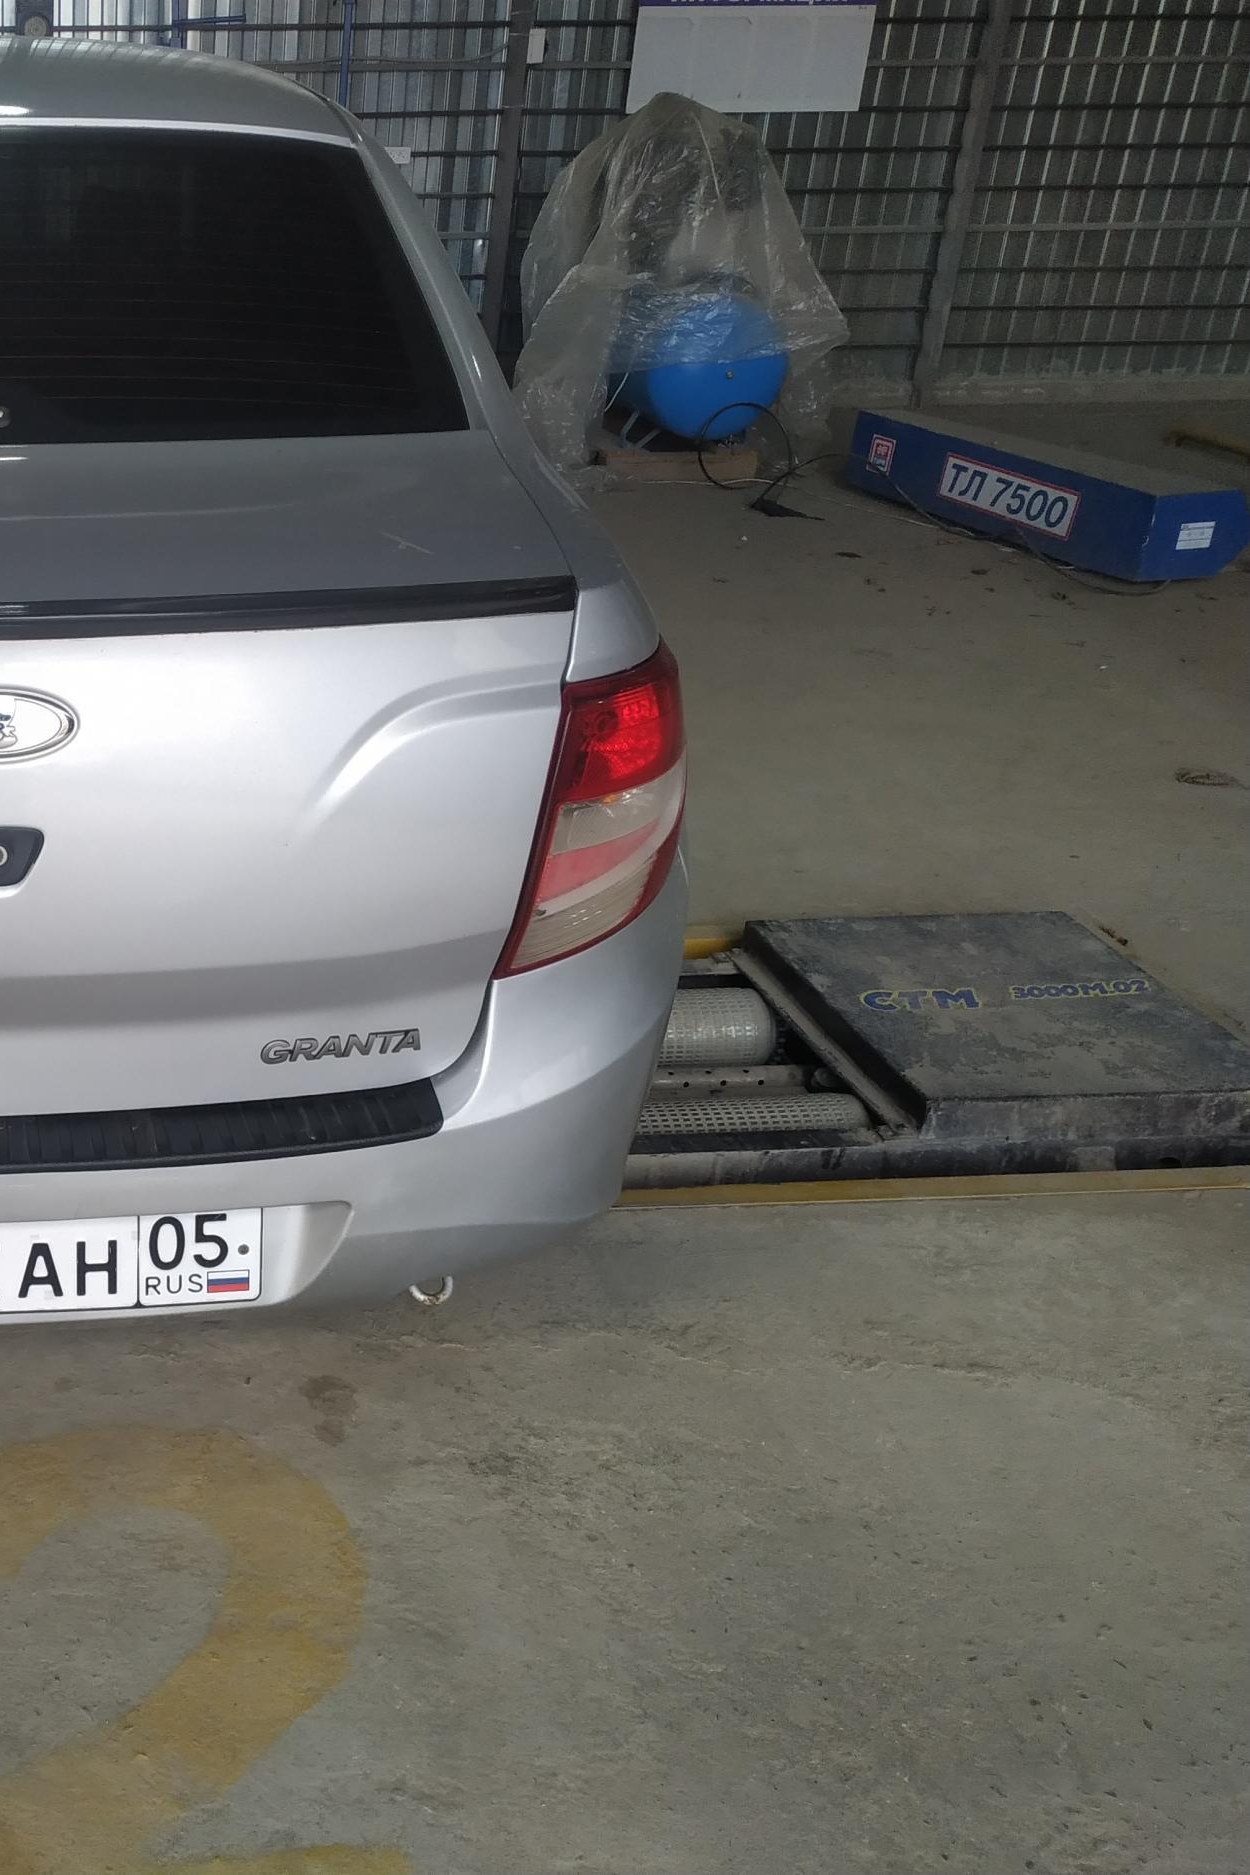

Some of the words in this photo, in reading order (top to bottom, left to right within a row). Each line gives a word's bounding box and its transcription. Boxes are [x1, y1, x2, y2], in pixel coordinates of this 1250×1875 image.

[947, 463, 986, 497] ТЛ
[989, 478, 1069, 529] 7500
[259, 1028, 421, 1065] GRANTA
[149, 1213, 230, 1271] 05
[145, 1272, 204, 1297] RUS
